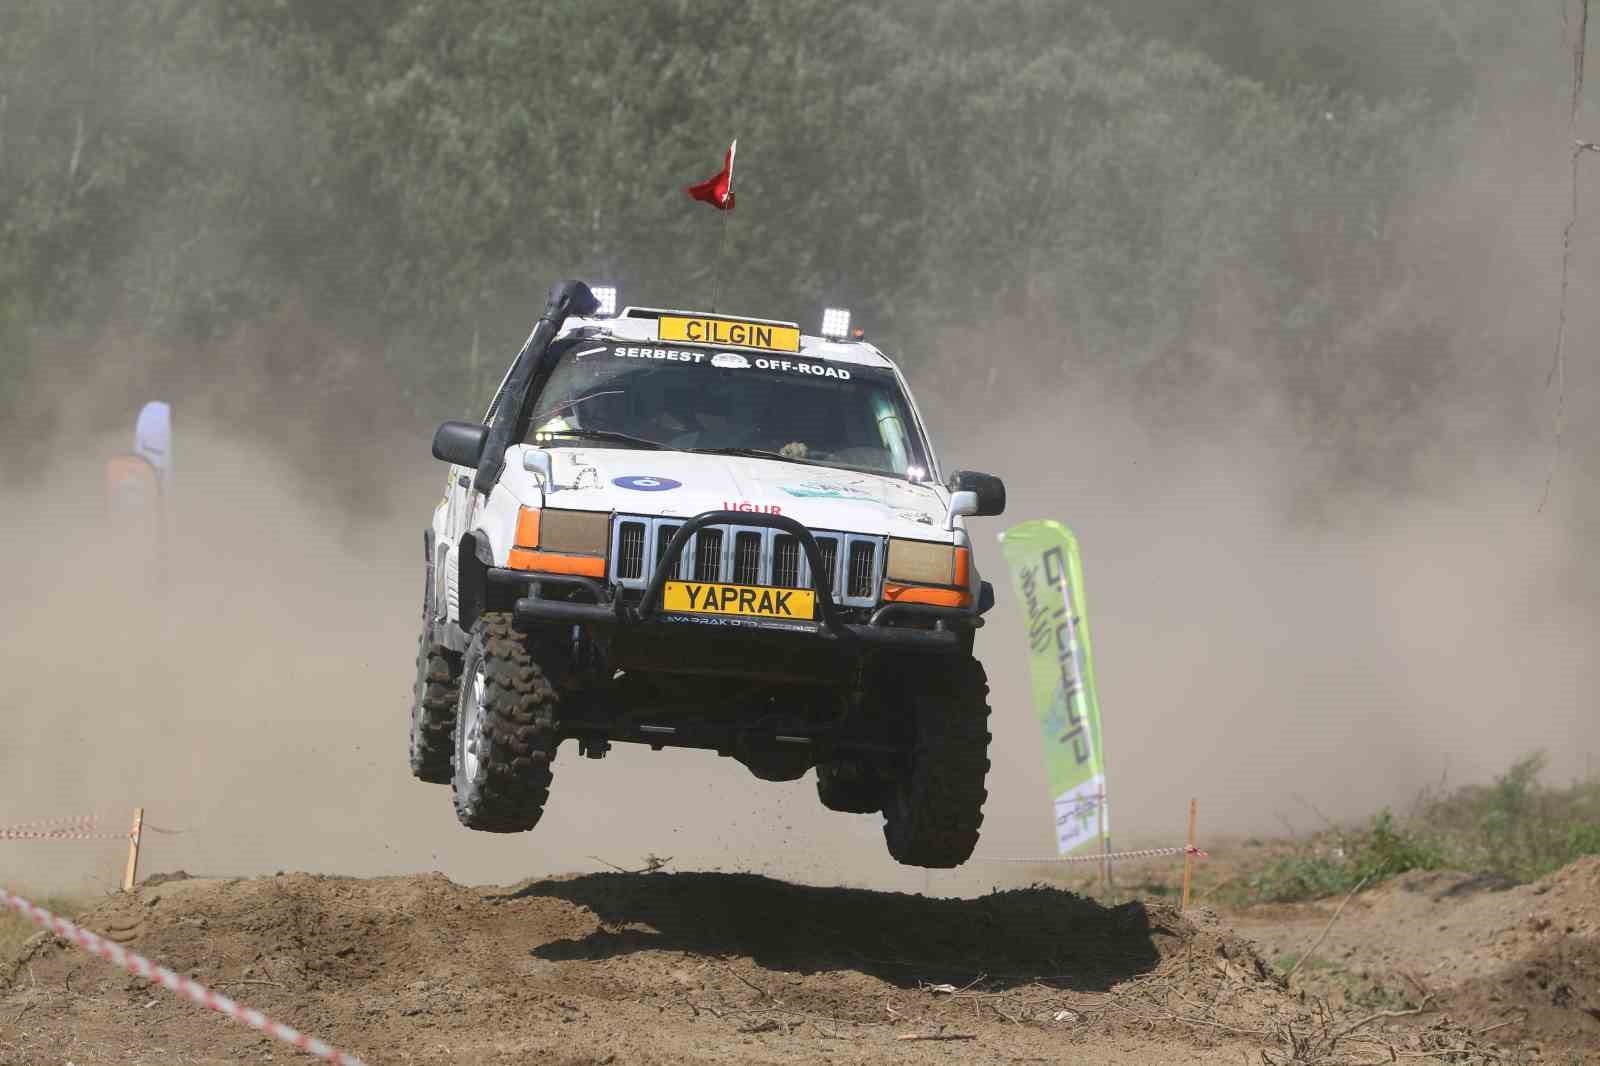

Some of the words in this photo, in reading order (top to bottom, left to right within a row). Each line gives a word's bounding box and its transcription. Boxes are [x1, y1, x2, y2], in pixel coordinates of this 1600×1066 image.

[613, 346, 705, 364] SERBEST
[754, 358, 851, 380] OFF-ROAD
[685, 585, 792, 615] YAPRAK
